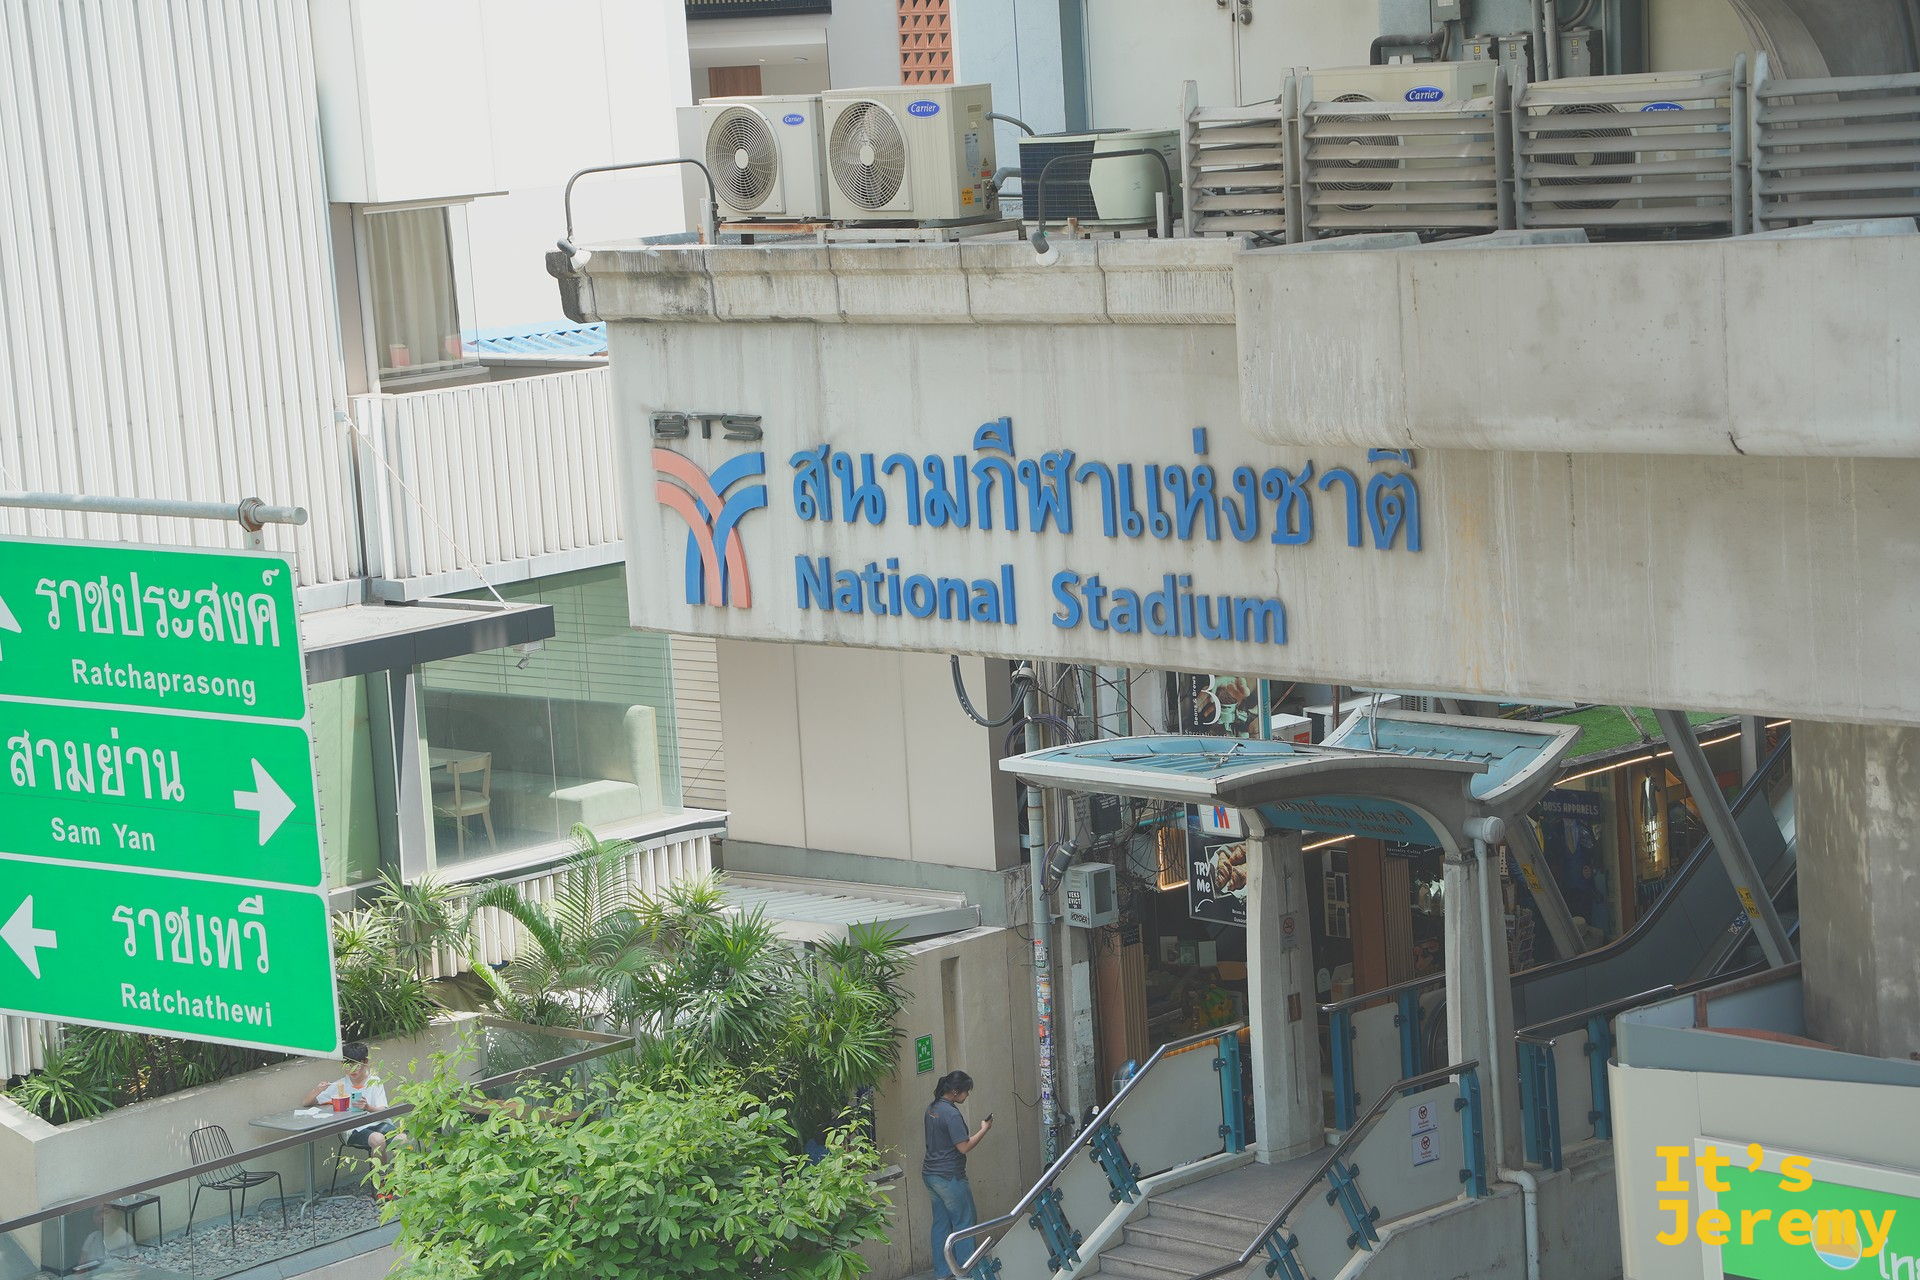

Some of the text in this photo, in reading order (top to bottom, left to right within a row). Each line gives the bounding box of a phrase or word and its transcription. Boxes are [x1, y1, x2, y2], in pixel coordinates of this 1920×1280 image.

[910, 103, 937, 114] Carrier
[1408, 89, 1440, 101] Carrier
[784, 115, 802, 124] Carrier
[648, 411, 764, 442] BTS
[788, 416, 1422, 553] สนามกีฬาแห่งชาติ
[35, 568, 281, 648] ราชประสงค์
[795, 555, 1287, 645] National Stadium
[72, 658, 257, 706] Ratchaprasong
[7, 727, 186, 803] สามย่าน
[51, 817, 156, 851] Sam Yan
[1194, 861, 1211, 877] TRY
[1196, 878, 1211, 893] Me
[111, 894, 270, 974] ราชเทวี
[120, 982, 273, 1029] Ratchathewi
